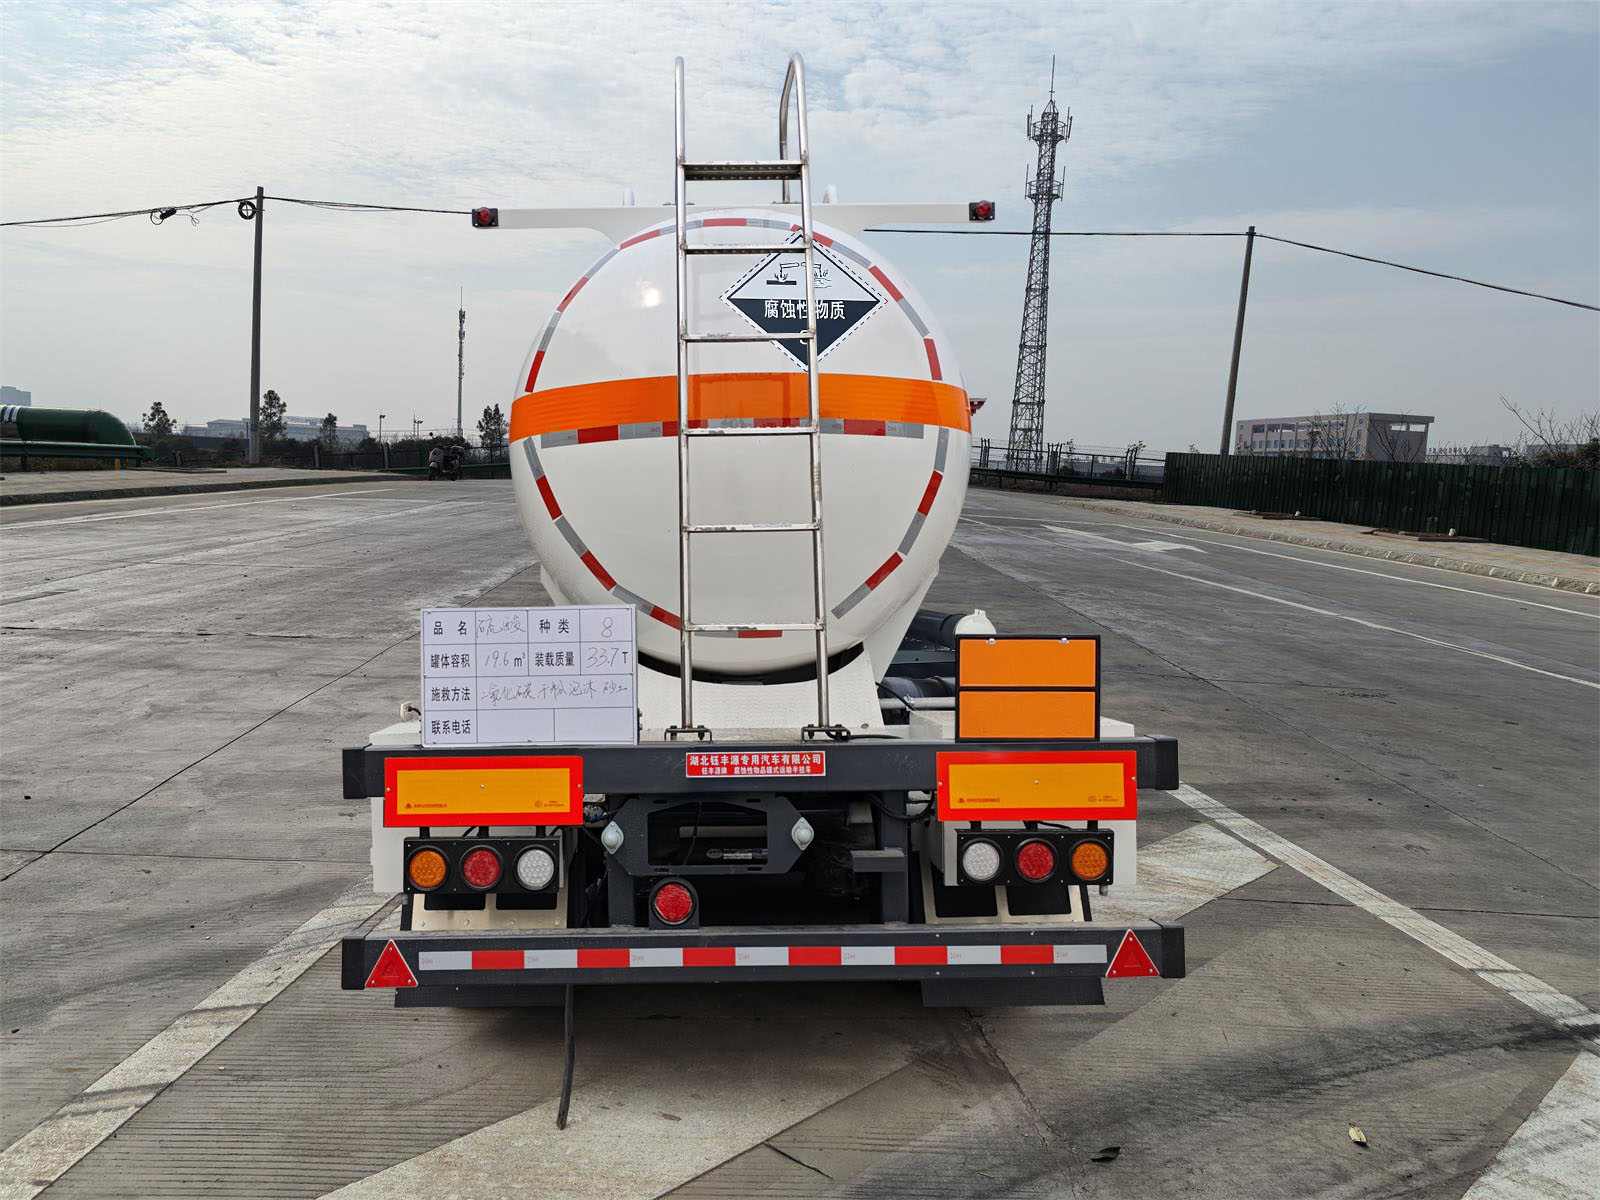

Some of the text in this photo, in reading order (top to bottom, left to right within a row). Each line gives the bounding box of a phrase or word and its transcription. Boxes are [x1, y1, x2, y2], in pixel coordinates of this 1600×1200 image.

[600, 616, 614, 638] 8
[430, 653, 471, 669] 罐体容积
[535, 651, 575, 667] 装载质量
[431, 686, 471, 702] 施救方法
[431, 719, 471, 735] 联系电话
